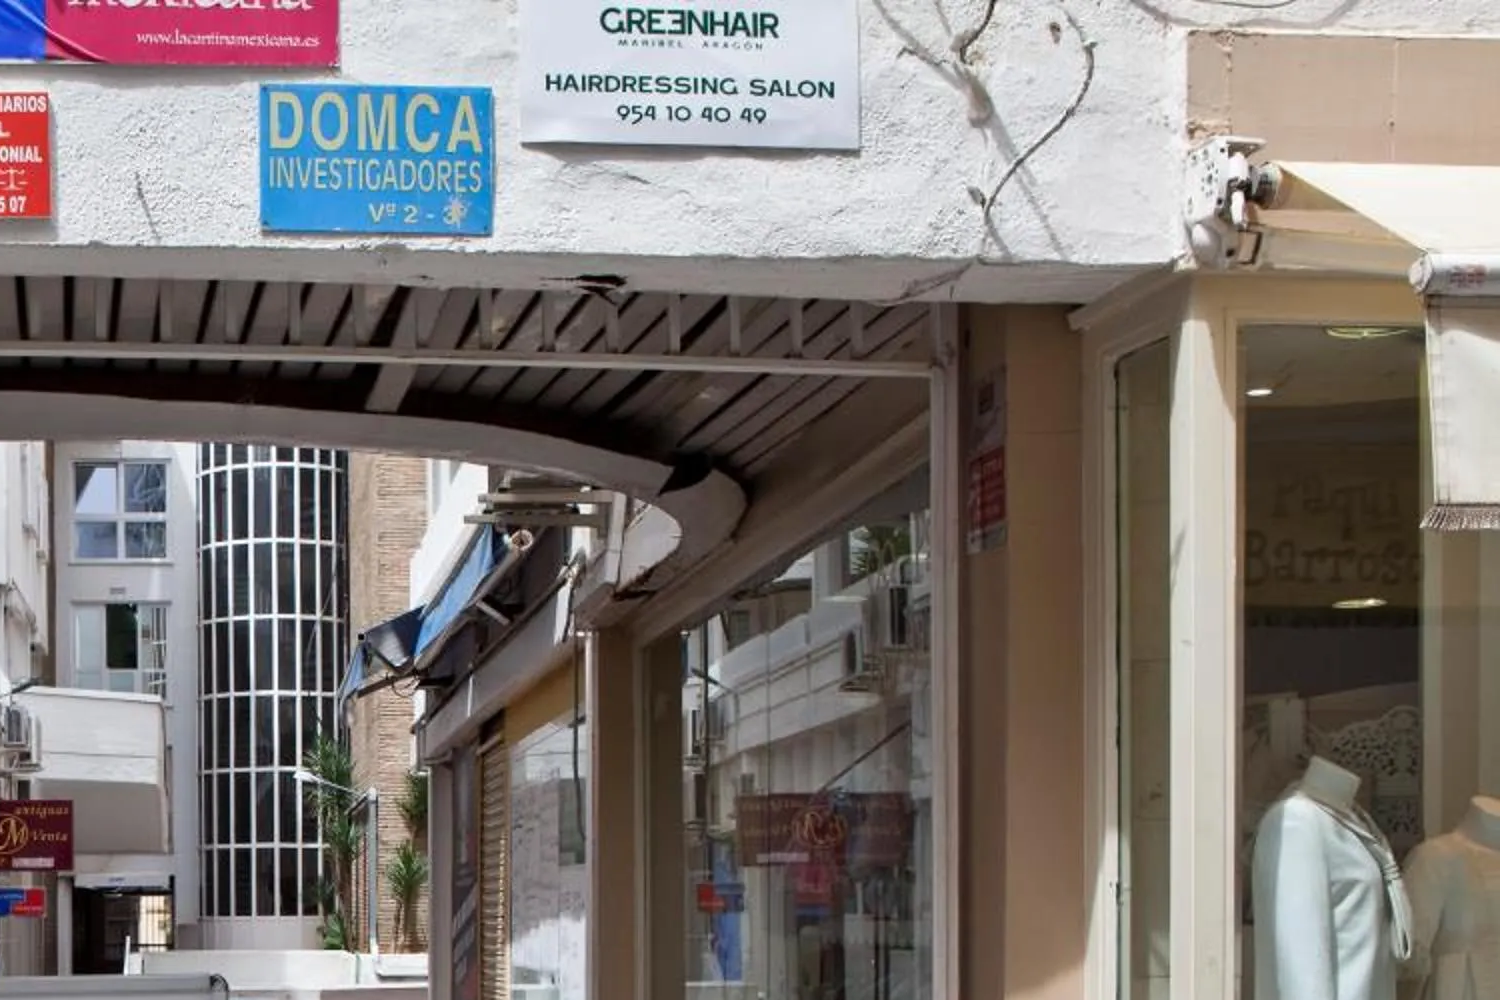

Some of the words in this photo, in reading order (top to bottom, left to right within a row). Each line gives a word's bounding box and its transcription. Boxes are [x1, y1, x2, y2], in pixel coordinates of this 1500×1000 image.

[600, 8, 779, 39] GREENHAIR
[137, 28, 320, 47] www.lacantinamexicana.es
[617, 38, 683, 49] MARIBEL
[545, 74, 738, 96] HAIRDRESSING
[750, 79, 835, 99] SALON
[268, 91, 483, 154] DOMCA
[617, 104, 656, 125] 954
[667, 106, 691, 122] 10
[701, 106, 731, 123] 40
[740, 107, 767, 125] 49
[268, 157, 483, 193] INVESTIGADORES
[9, 196, 27, 213] 07
[403, 204, 419, 224] 2
